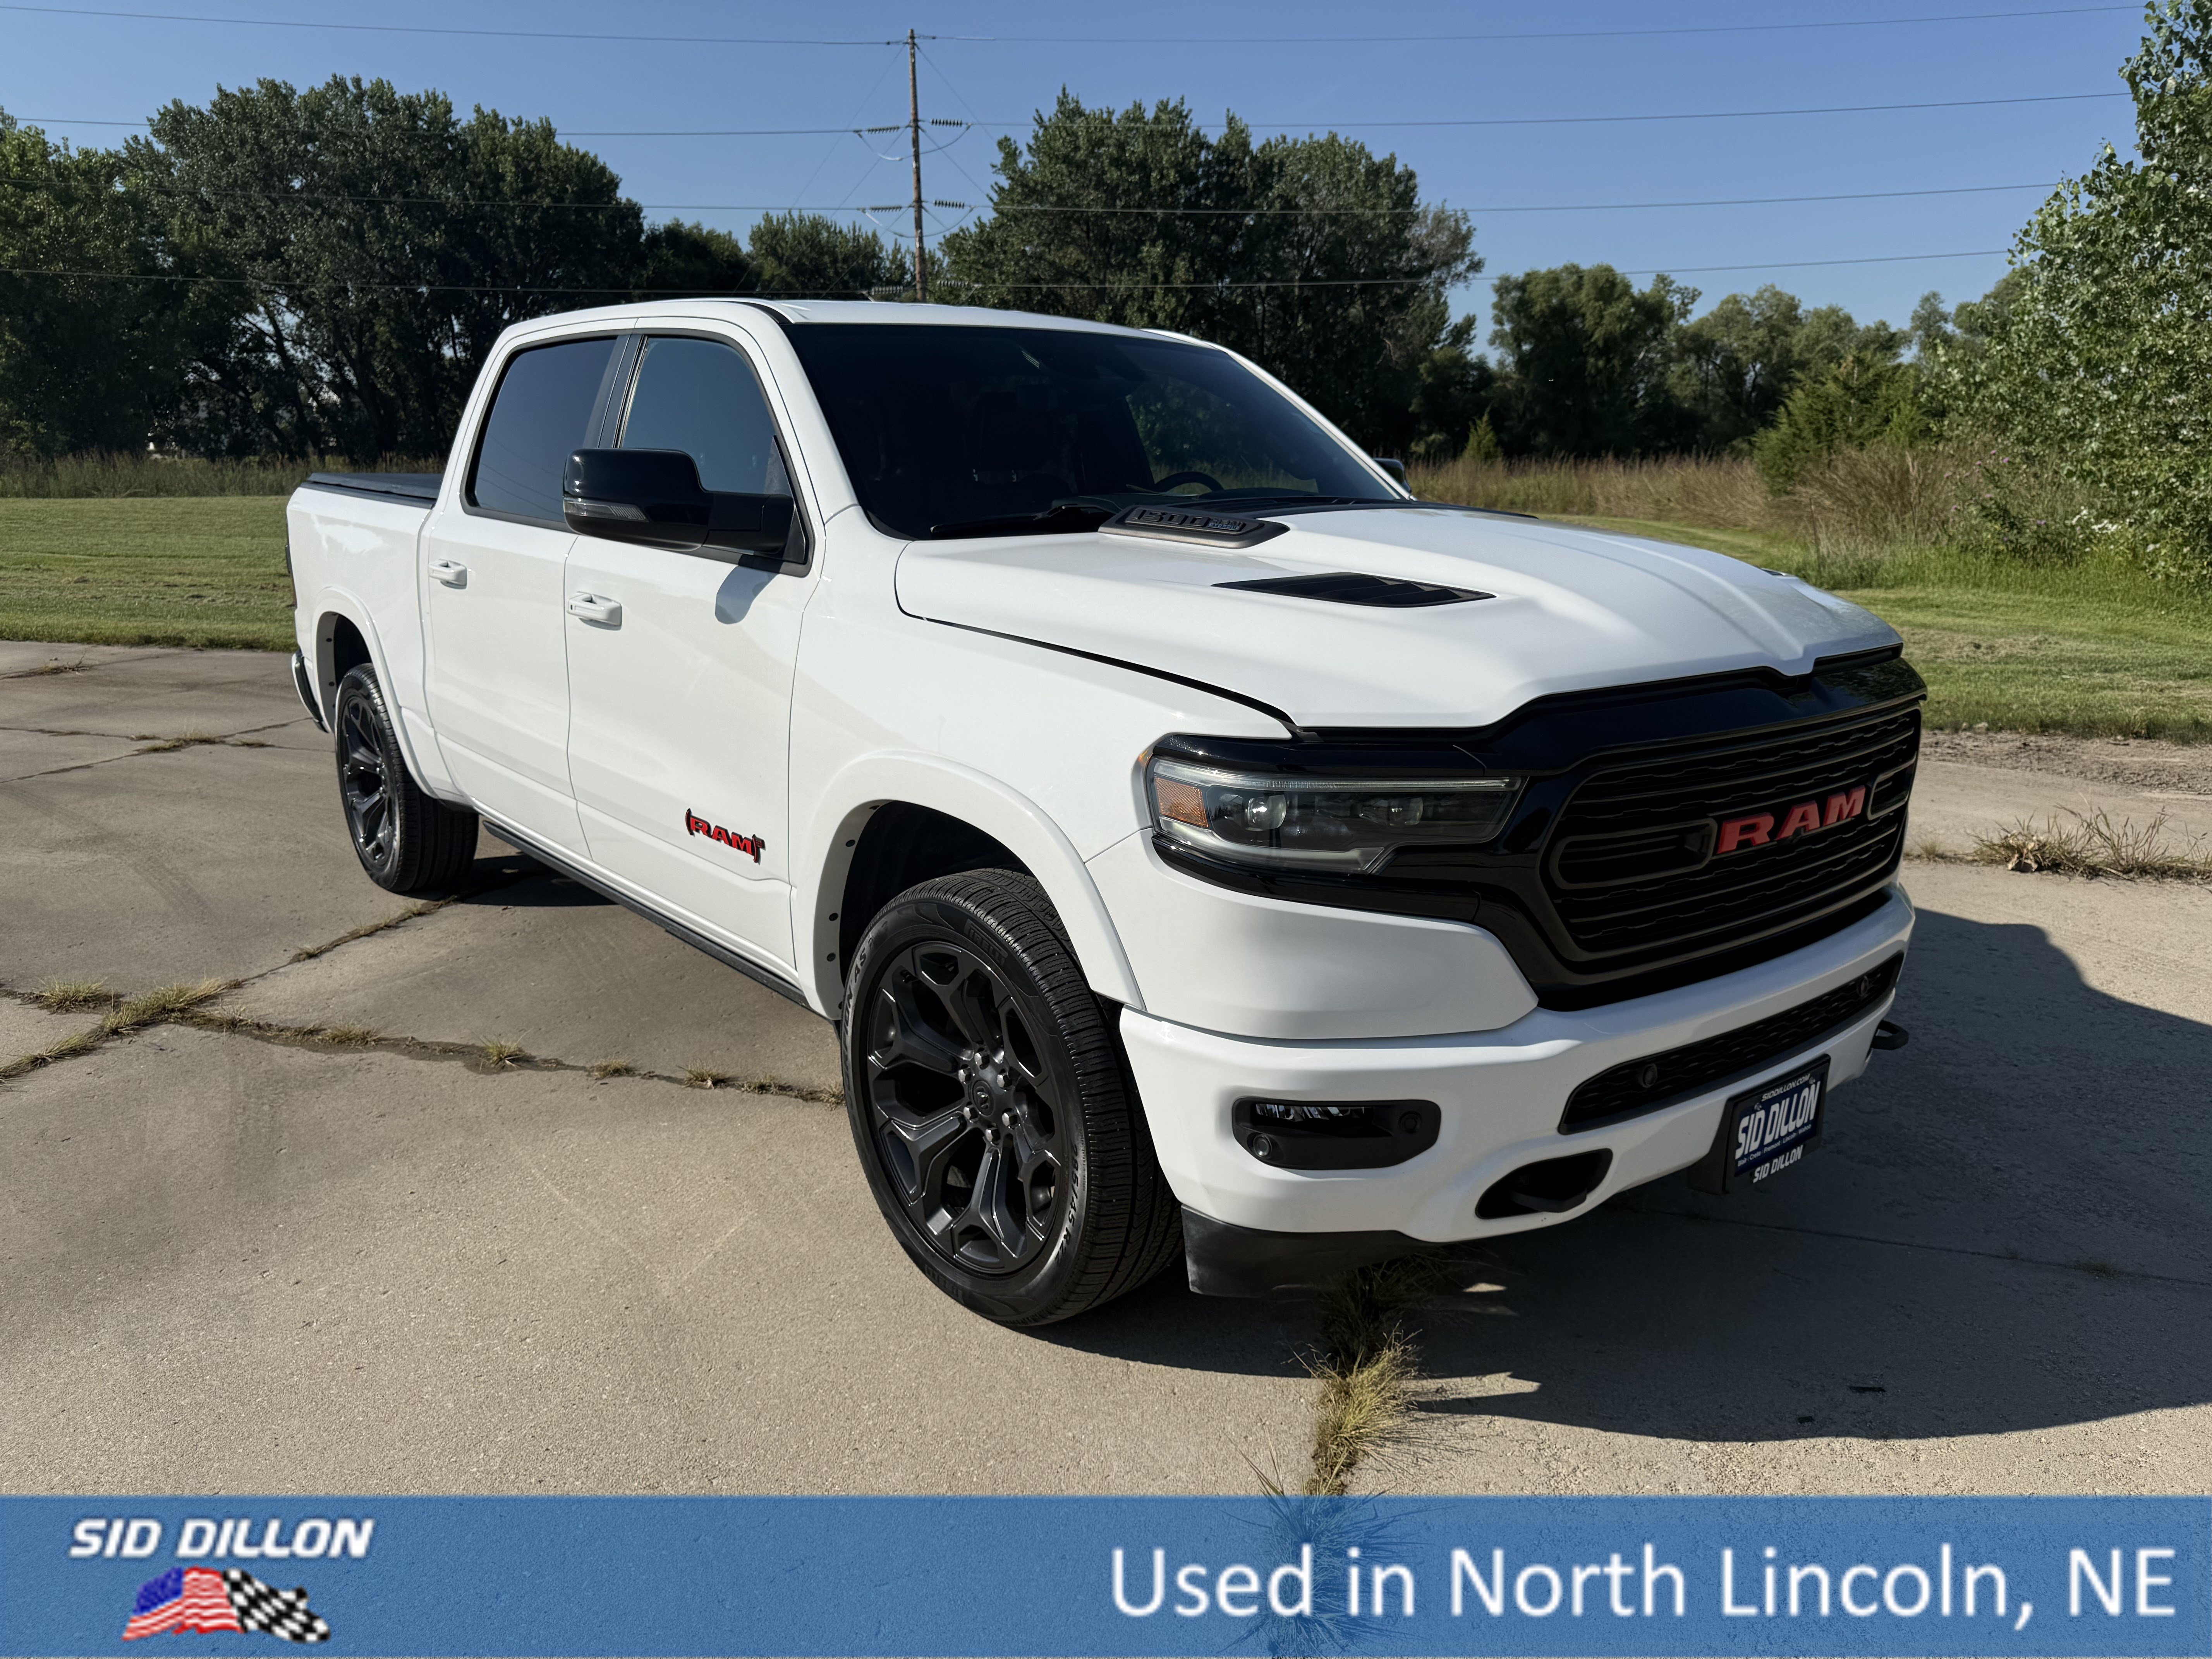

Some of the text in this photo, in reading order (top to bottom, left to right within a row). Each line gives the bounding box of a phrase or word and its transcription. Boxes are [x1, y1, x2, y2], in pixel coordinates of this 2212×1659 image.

[1133, 509, 1210, 527] 1500
[1717, 785, 1866, 854] RAM
[963, 918, 1008, 966] PIRELLI
[1735, 1081, 1820, 1160] SID DILLON
[1753, 1145, 1804, 1183] SID DILLON
